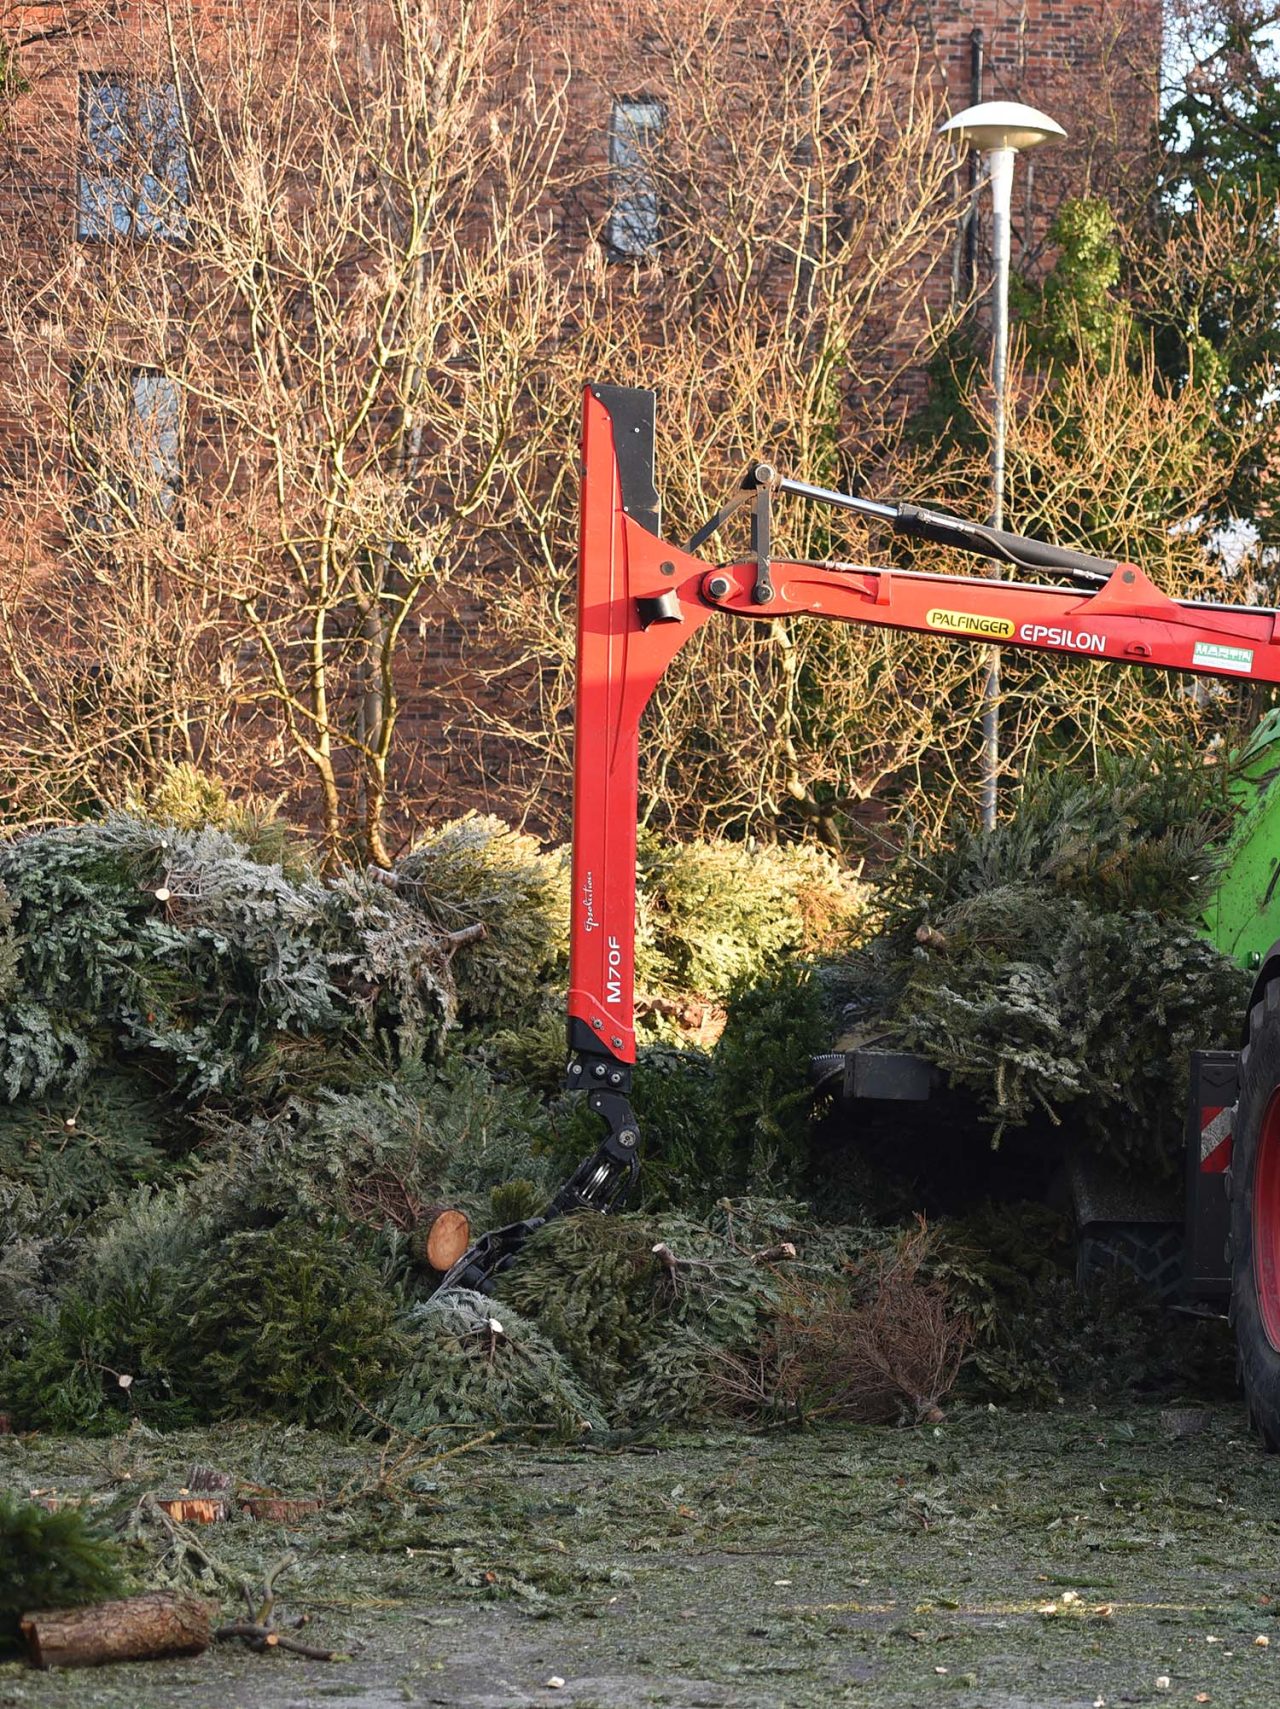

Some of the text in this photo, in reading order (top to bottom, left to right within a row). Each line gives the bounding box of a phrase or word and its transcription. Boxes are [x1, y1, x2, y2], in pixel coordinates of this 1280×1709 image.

[931, 611, 1106, 652] PALFINGER EPSILON
[1195, 642, 1253, 663] MARTIN
[606, 936, 621, 1003] M70F
